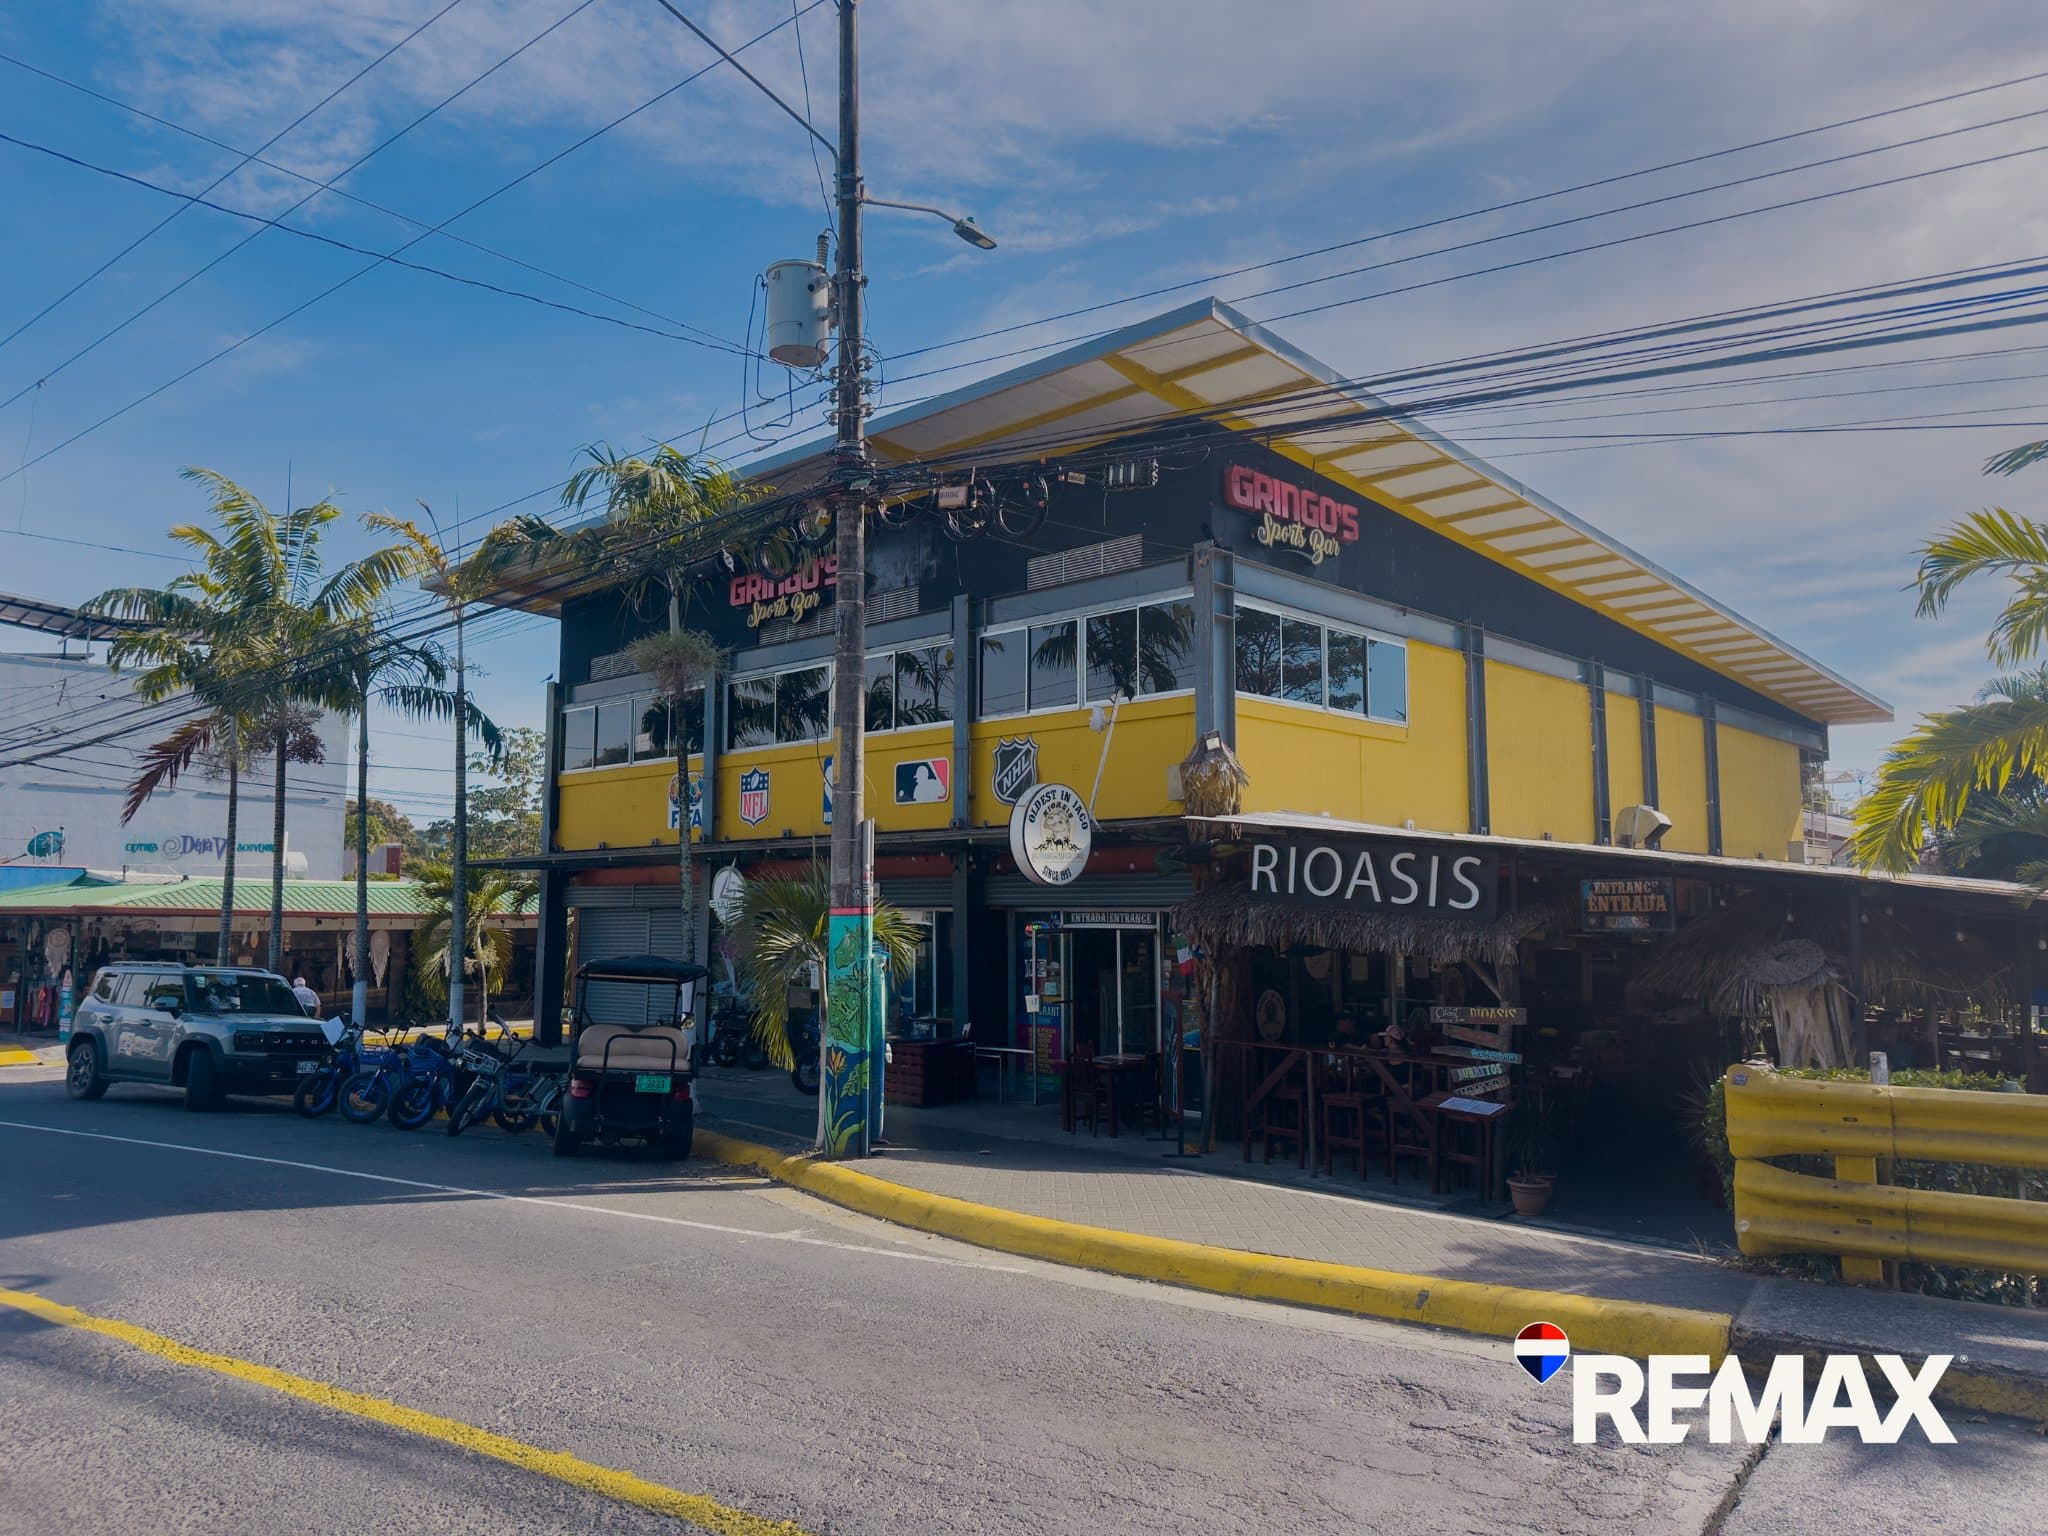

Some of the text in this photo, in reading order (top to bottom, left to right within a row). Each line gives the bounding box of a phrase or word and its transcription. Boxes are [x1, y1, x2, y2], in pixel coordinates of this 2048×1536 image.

[1228, 464, 1360, 542] GRINGO'S
[1257, 512, 1340, 565] Sports Bar
[747, 591, 820, 628] Sports Bar
[1002, 753, 1030, 793] NHL
[671, 808, 702, 829] FA
[743, 792, 767, 820] NFL
[1028, 789, 1057, 824] OLDEST
[1060, 790, 1071, 801] IN
[1251, 844, 1482, 910] RIOASIS
[1587, 895, 1667, 912] ENTRADA
